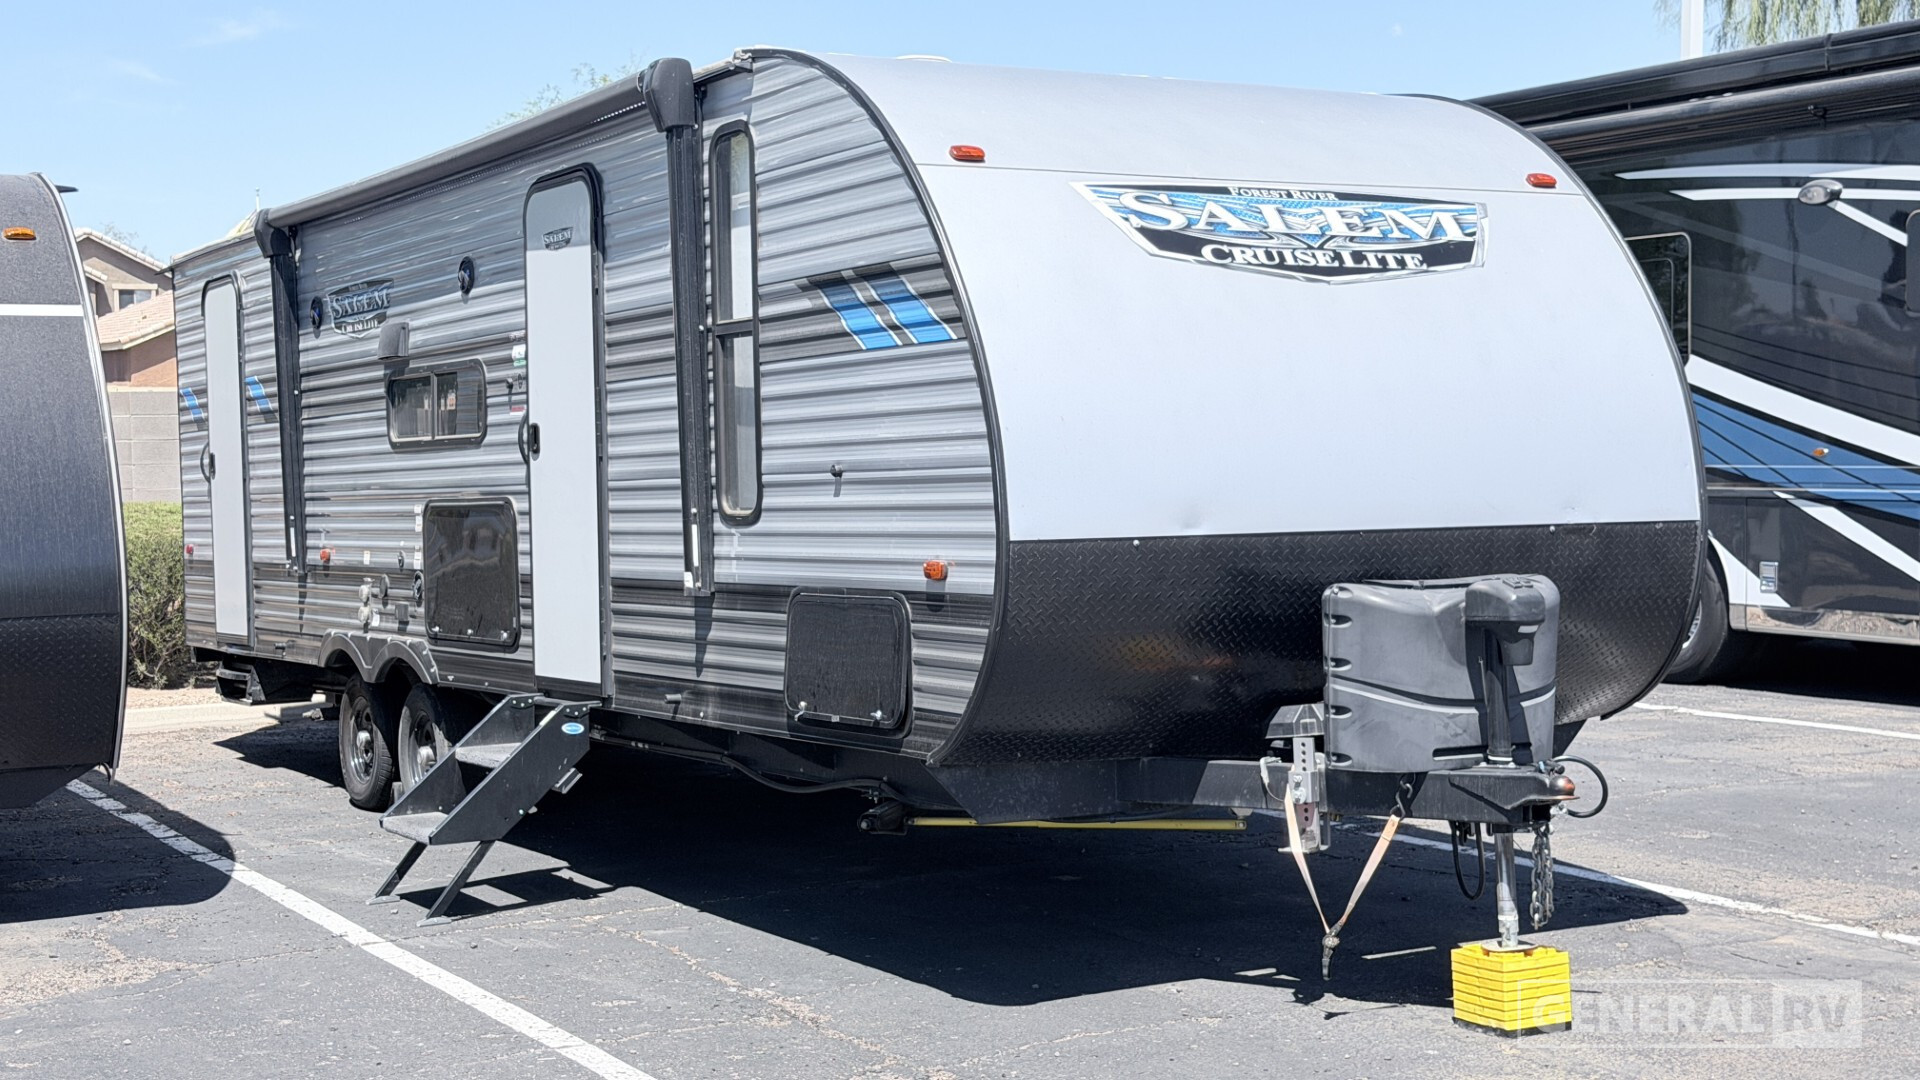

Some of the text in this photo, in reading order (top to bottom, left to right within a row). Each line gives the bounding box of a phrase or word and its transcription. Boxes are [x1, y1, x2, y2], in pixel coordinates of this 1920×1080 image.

[1227, 186, 1339, 201] FOREST RIVER
[1120, 190, 1477, 241] SALEM
[333, 289, 390, 318] SALEM
